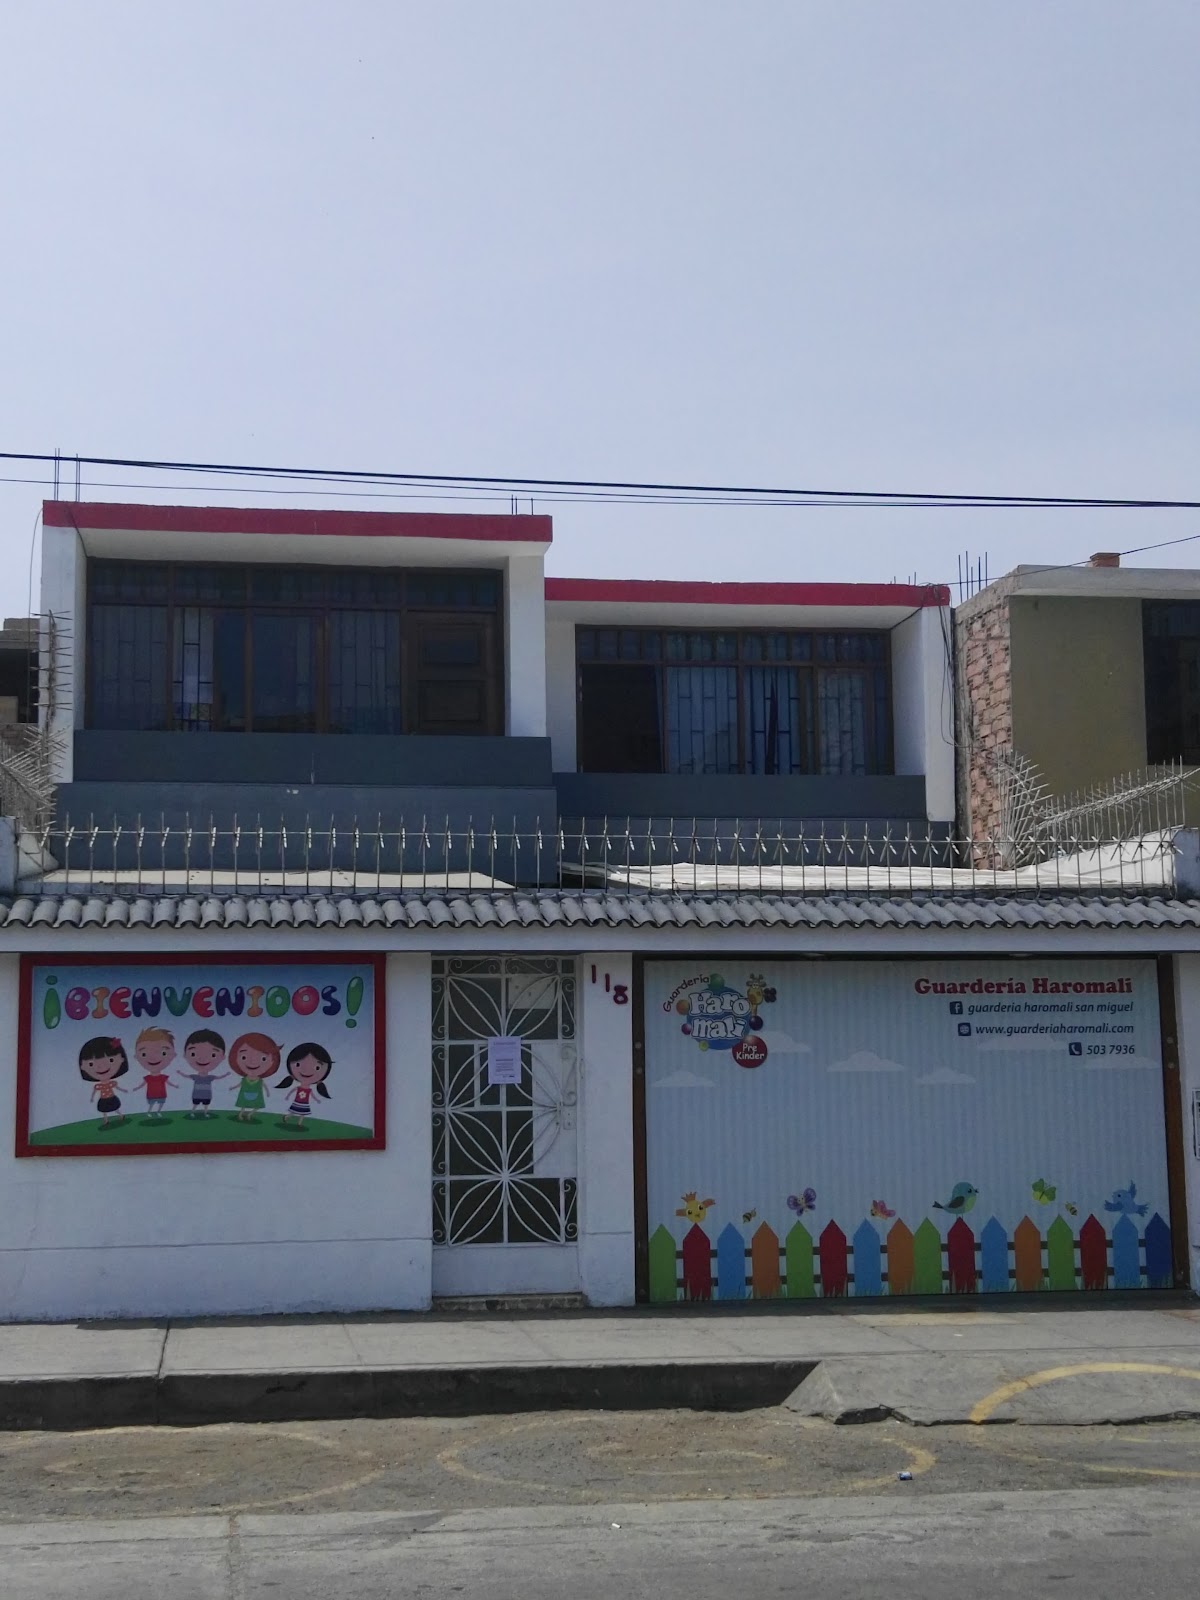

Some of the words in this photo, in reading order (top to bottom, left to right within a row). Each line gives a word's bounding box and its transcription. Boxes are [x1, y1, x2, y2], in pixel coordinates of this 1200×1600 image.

[591, 964, 629, 1005] 118
[663, 974, 709, 1012] Guardería
[1032, 977, 1133, 994] Haromali
[42, 974, 364, 1030] ¡BIENVENIDOS!
[690, 991, 751, 1015] Haro
[968, 1002, 1022, 1014] guarderia
[1024, 1001, 1073, 1013] haromali
[1075, 1003, 1094, 1013] san
[1096, 1001, 1134, 1014] miguel
[691, 1016, 746, 1039] mali
[975, 1022, 1134, 1036] www.guarderiaharomali.com
[736, 1051, 765, 1060] Kinder
[742, 1043, 757, 1053] Pre
[1086, 1044, 1106, 1055] 503
[1109, 1044, 1135, 1055] 7936
